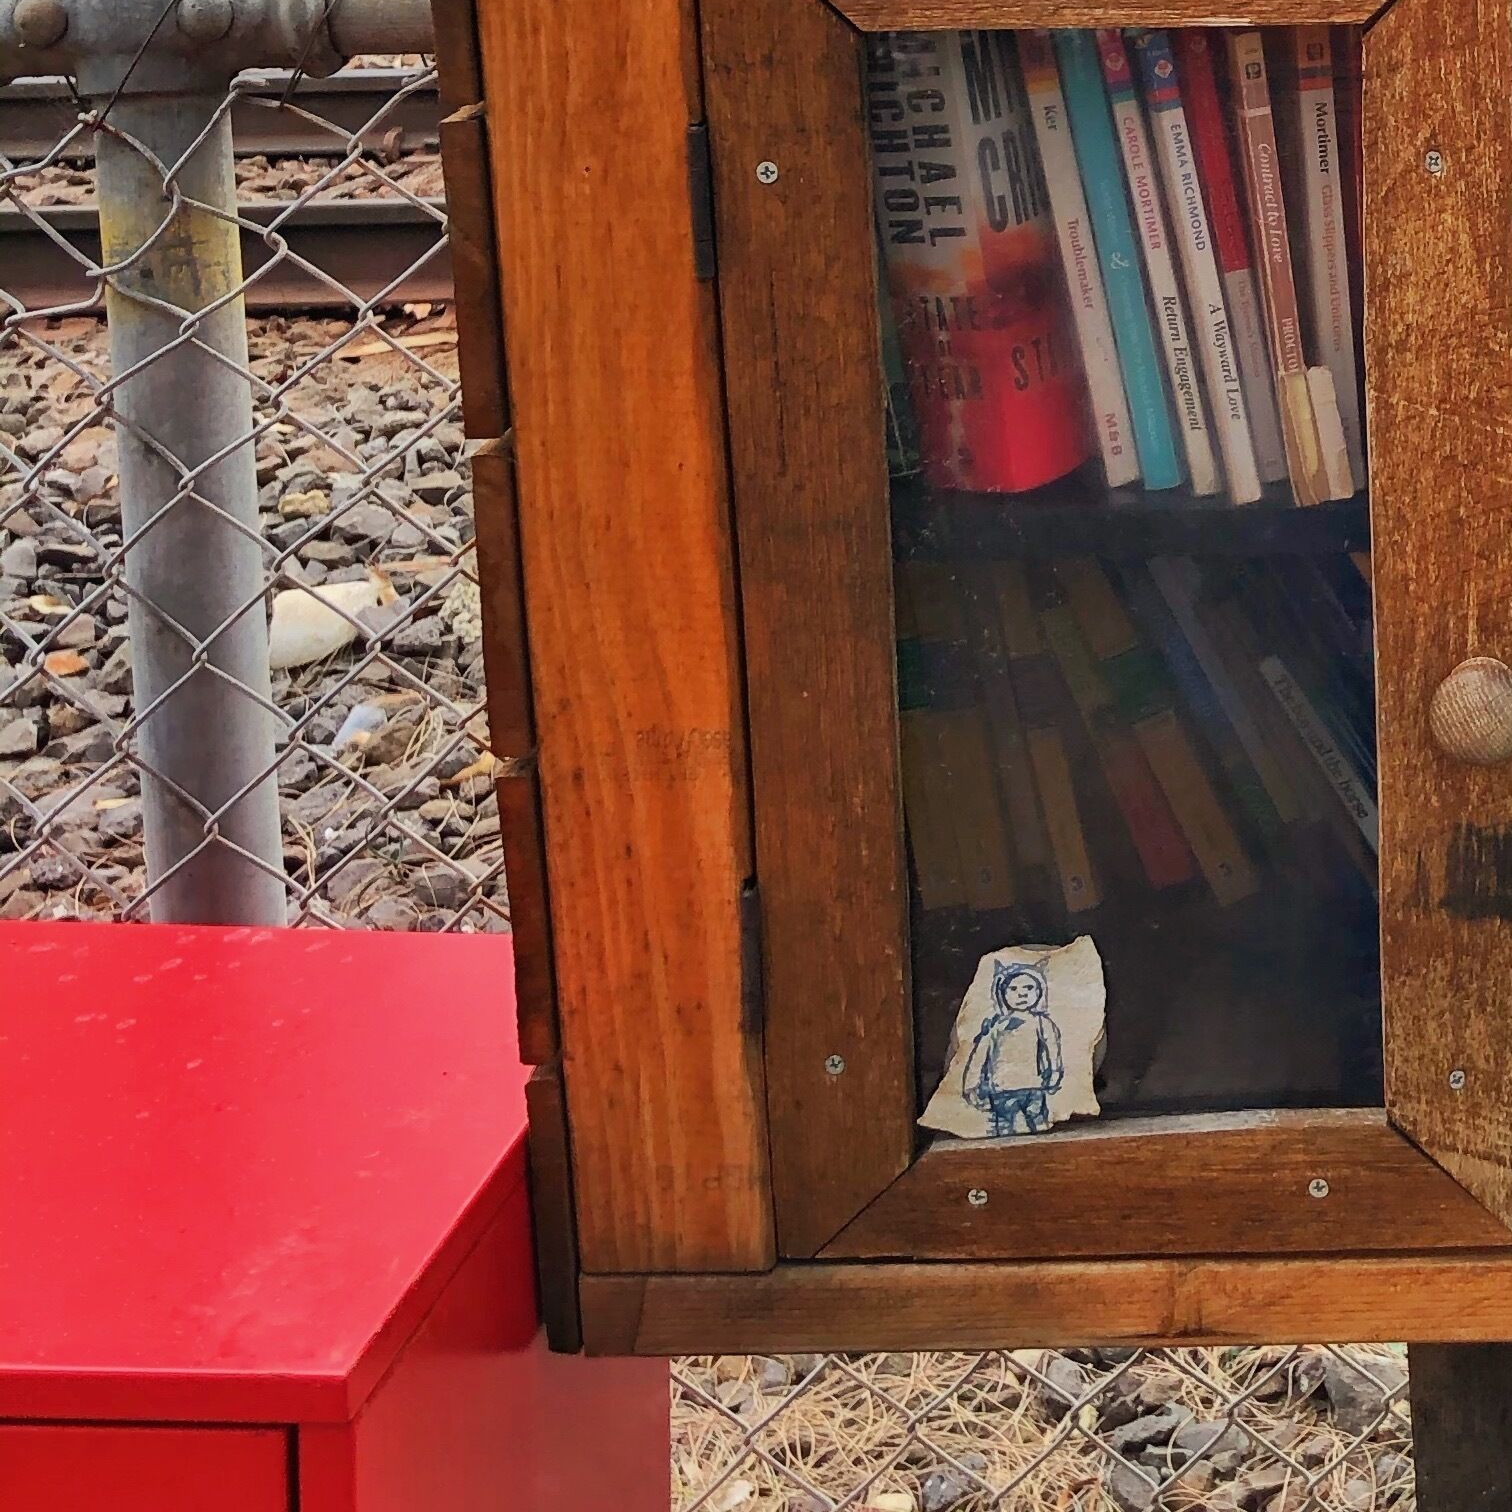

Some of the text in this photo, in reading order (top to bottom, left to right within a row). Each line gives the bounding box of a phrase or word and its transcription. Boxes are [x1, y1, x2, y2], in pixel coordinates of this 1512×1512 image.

[1314, 102, 1331, 174] Mortimer
[1043, 104, 1058, 131] Ker
[1067, 218, 1095, 309] Troublemaker
[1257, 143, 1281, 206] Contract
[1269, 229, 1283, 264] Love
[1319, 184, 1333, 218] Glass
[1322, 219, 1337, 270] Slippers
[1123, 115, 1145, 171] CAROLE
[1135, 174, 1161, 251] MORTIMER
[1162, 295, 1181, 343] Return
[1174, 345, 1202, 431] Engagement
[1170, 123, 1241, 420] EMMA RICHMOND A Wayward Love
[1330, 296, 1343, 352] Unicorns
